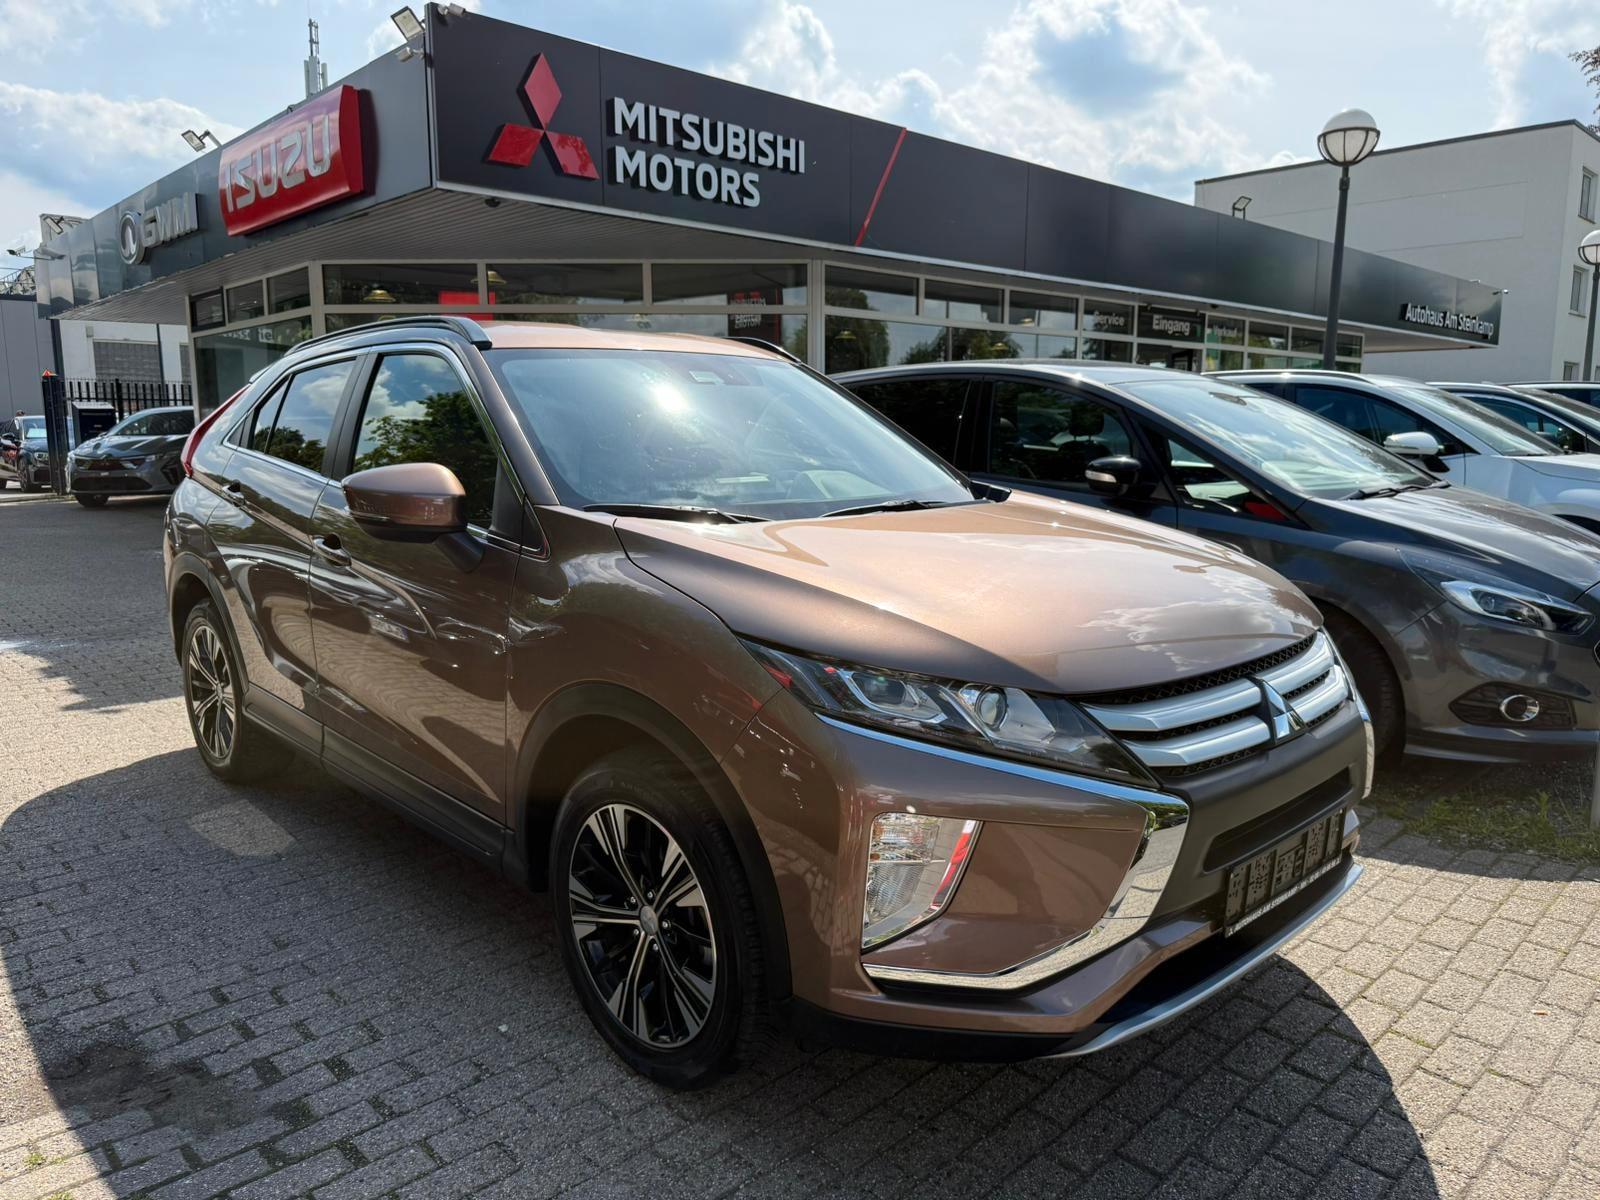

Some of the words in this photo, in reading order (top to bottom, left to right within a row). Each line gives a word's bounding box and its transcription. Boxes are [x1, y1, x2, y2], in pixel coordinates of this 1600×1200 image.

[613, 96, 806, 174] MITSUBISHI
[224, 114, 333, 214] ISUZU
[615, 145, 761, 208] MOTORS
[142, 192, 198, 247] GWM
[1093, 311, 1125, 326] Service
[1152, 314, 1191, 336] Eingang
[1405, 302, 1444, 327] Autohaus
[1444, 311, 1458, 329] Am
[1458, 313, 1494, 339] Steinkamp
